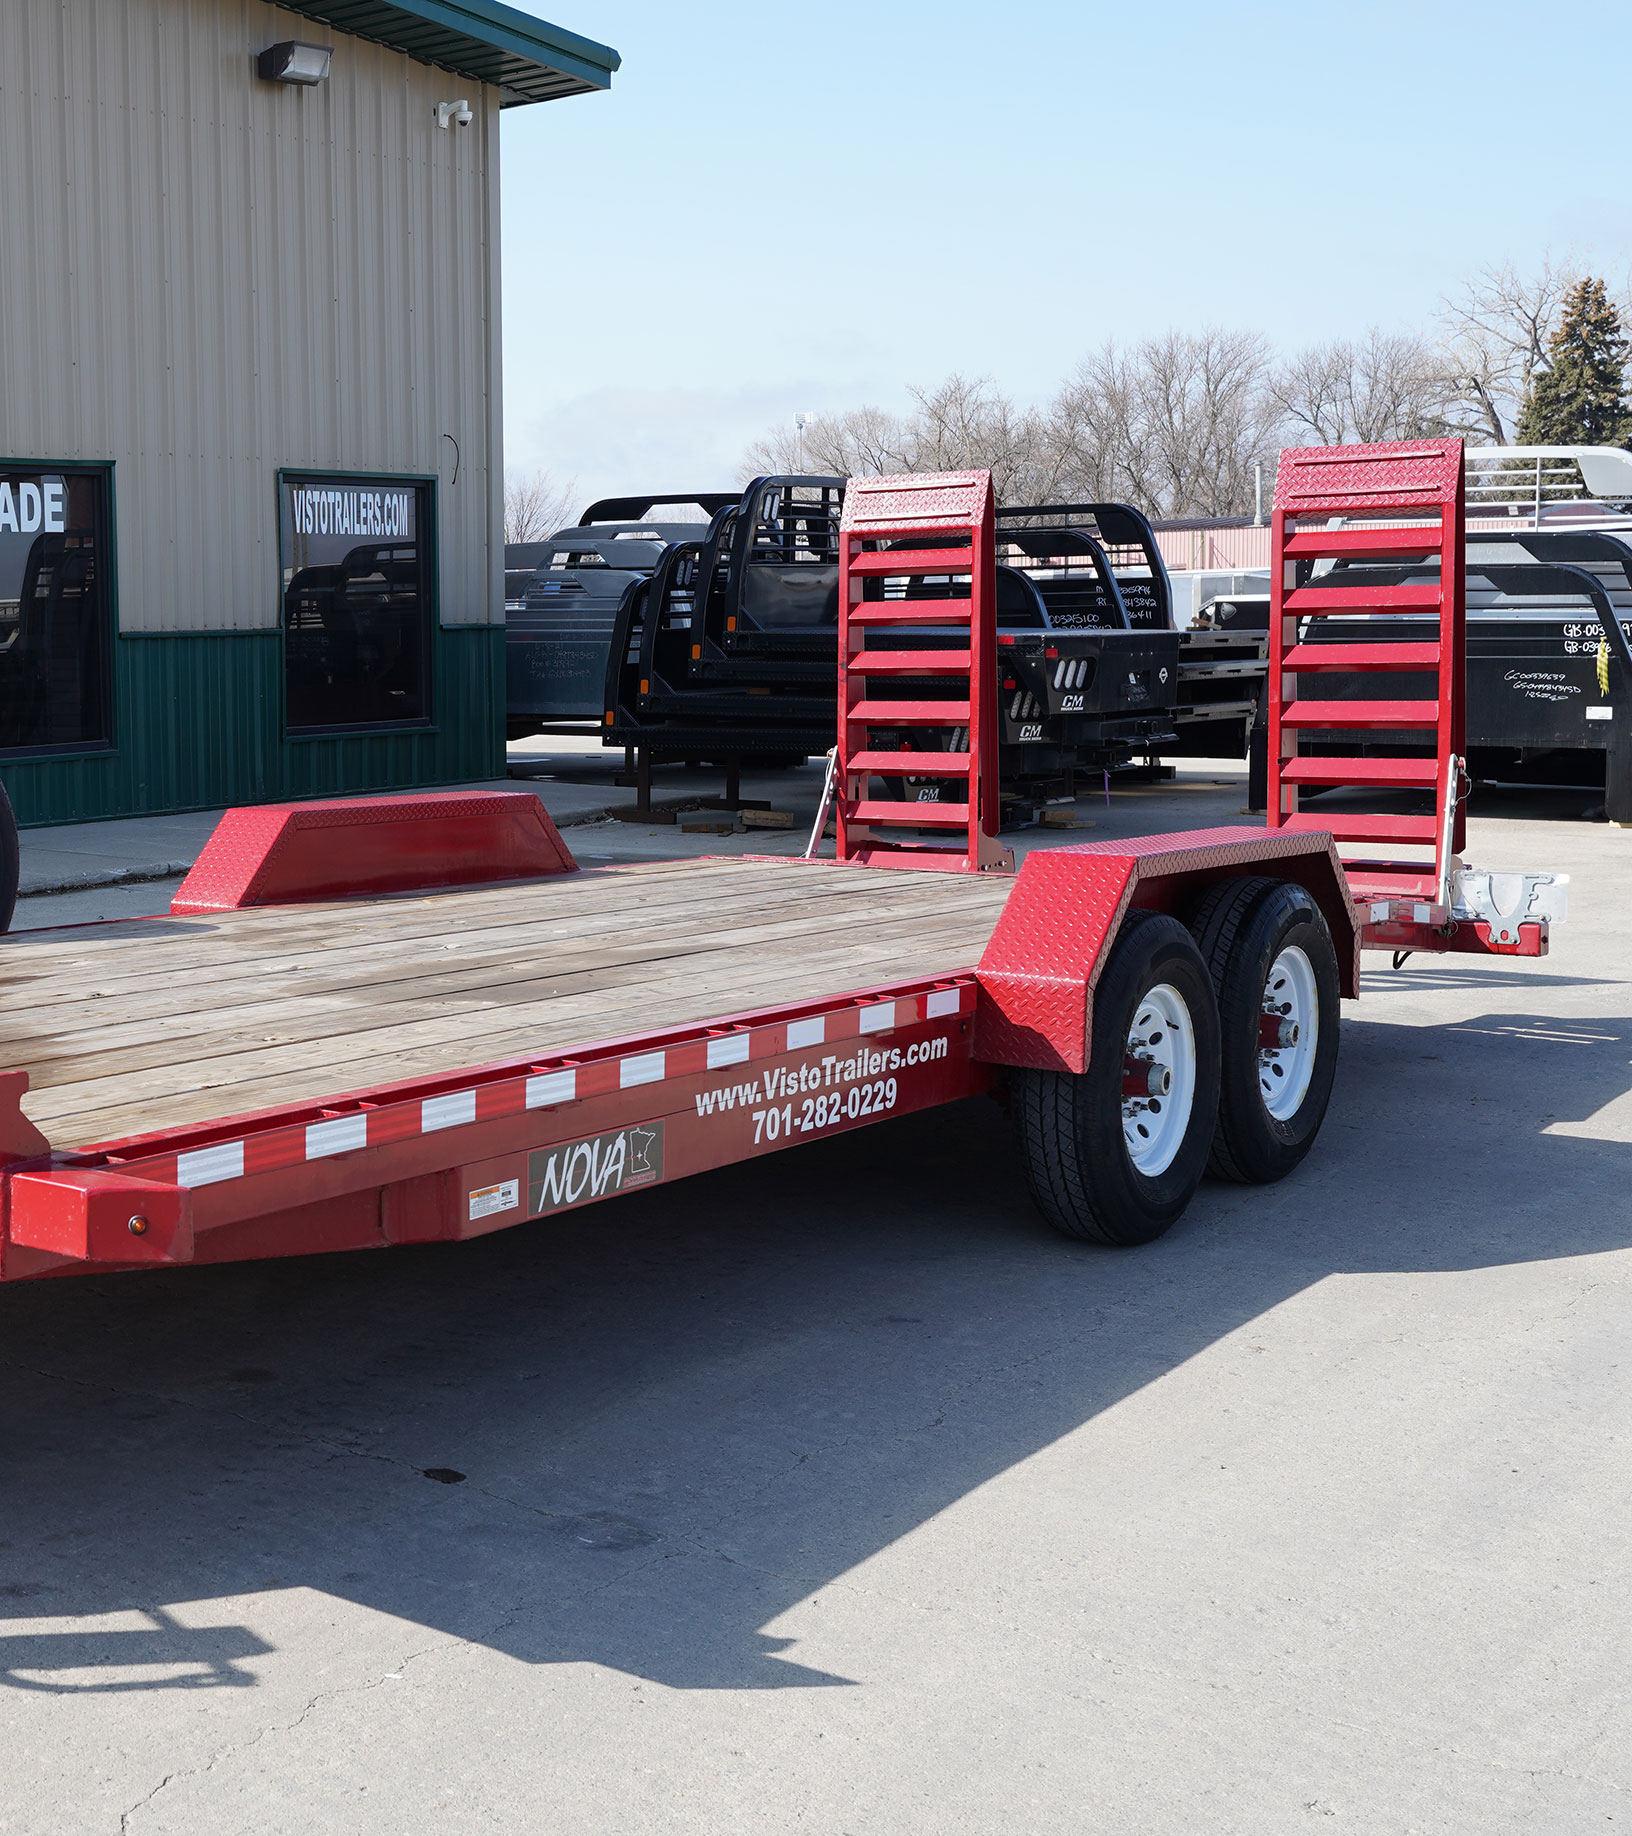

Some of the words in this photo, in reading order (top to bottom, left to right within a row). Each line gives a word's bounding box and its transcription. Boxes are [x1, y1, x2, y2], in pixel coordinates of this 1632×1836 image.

[292, 488, 409, 538] VISTOTRAILERS.COM
[1062, 695, 1084, 707] CM
[1020, 725, 1042, 737] CM
[918, 788, 939, 801] CM
[695, 1036, 948, 1117] www.VistoTrailers.com
[752, 1077, 898, 1145] 701-282-0229
[537, 1131, 627, 1213] NOVA
